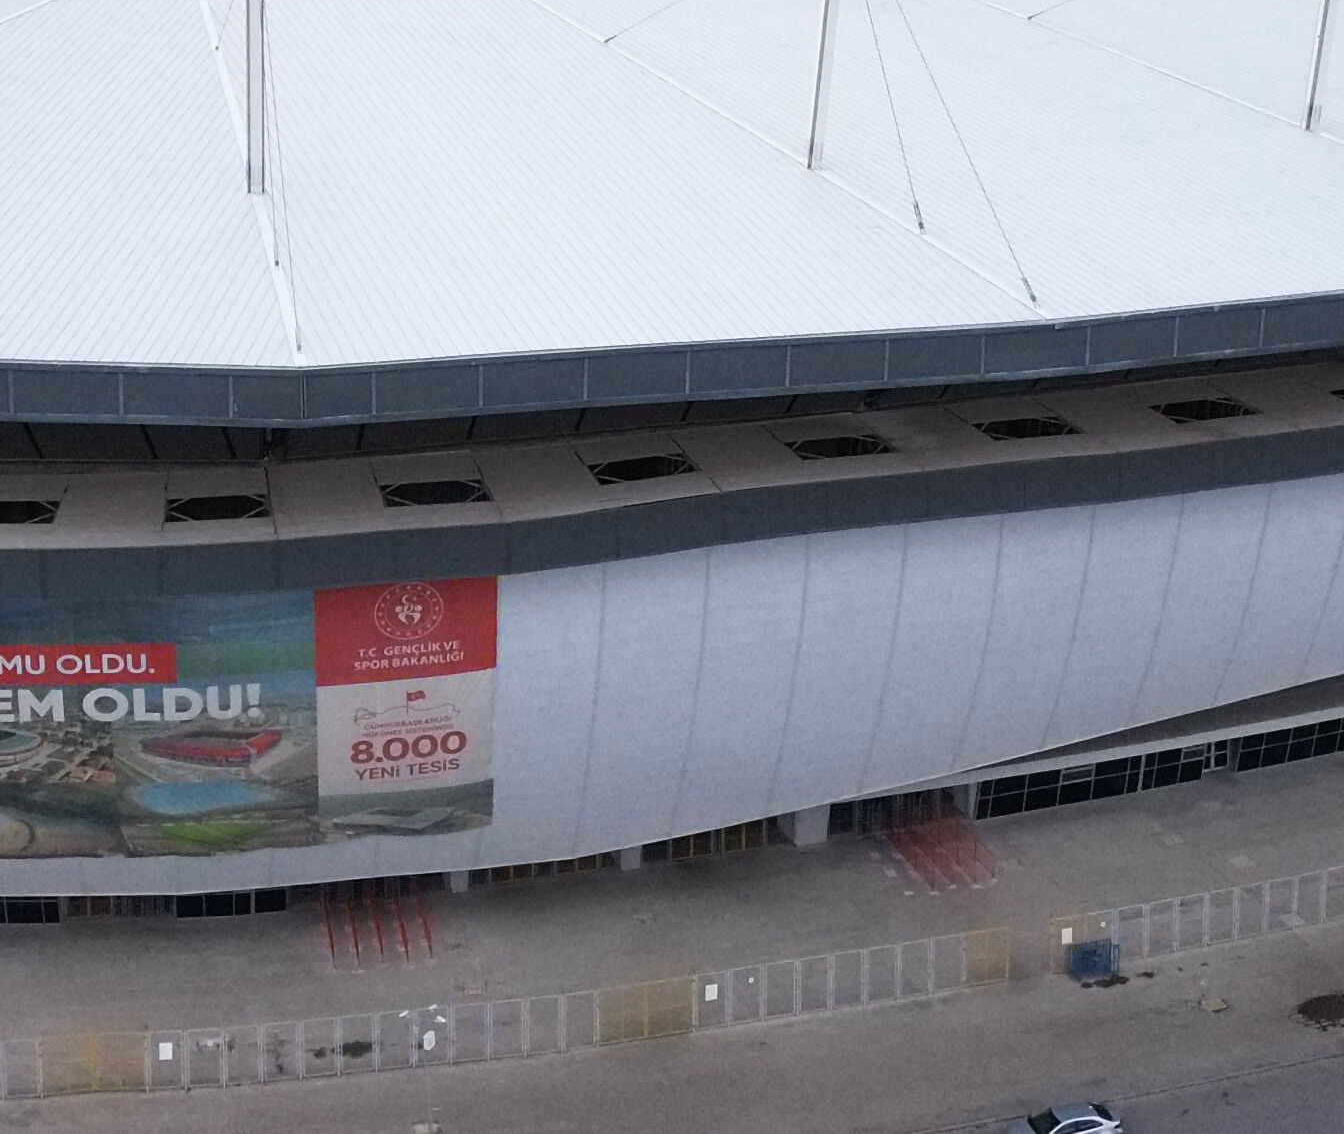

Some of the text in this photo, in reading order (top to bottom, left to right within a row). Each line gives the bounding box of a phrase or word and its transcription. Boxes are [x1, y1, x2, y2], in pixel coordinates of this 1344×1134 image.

[383, 642, 441, 656] GENÇLİK
[443, 640, 460, 651] VE
[56, 653, 156, 675] OLDU.
[354, 651, 465, 671] SPOR BAKANLIĞI
[82, 683, 261, 722] OLDU!
[350, 730, 467, 764] 8.000
[355, 765, 400, 781] YENİ
[407, 758, 461, 776] TESİS
